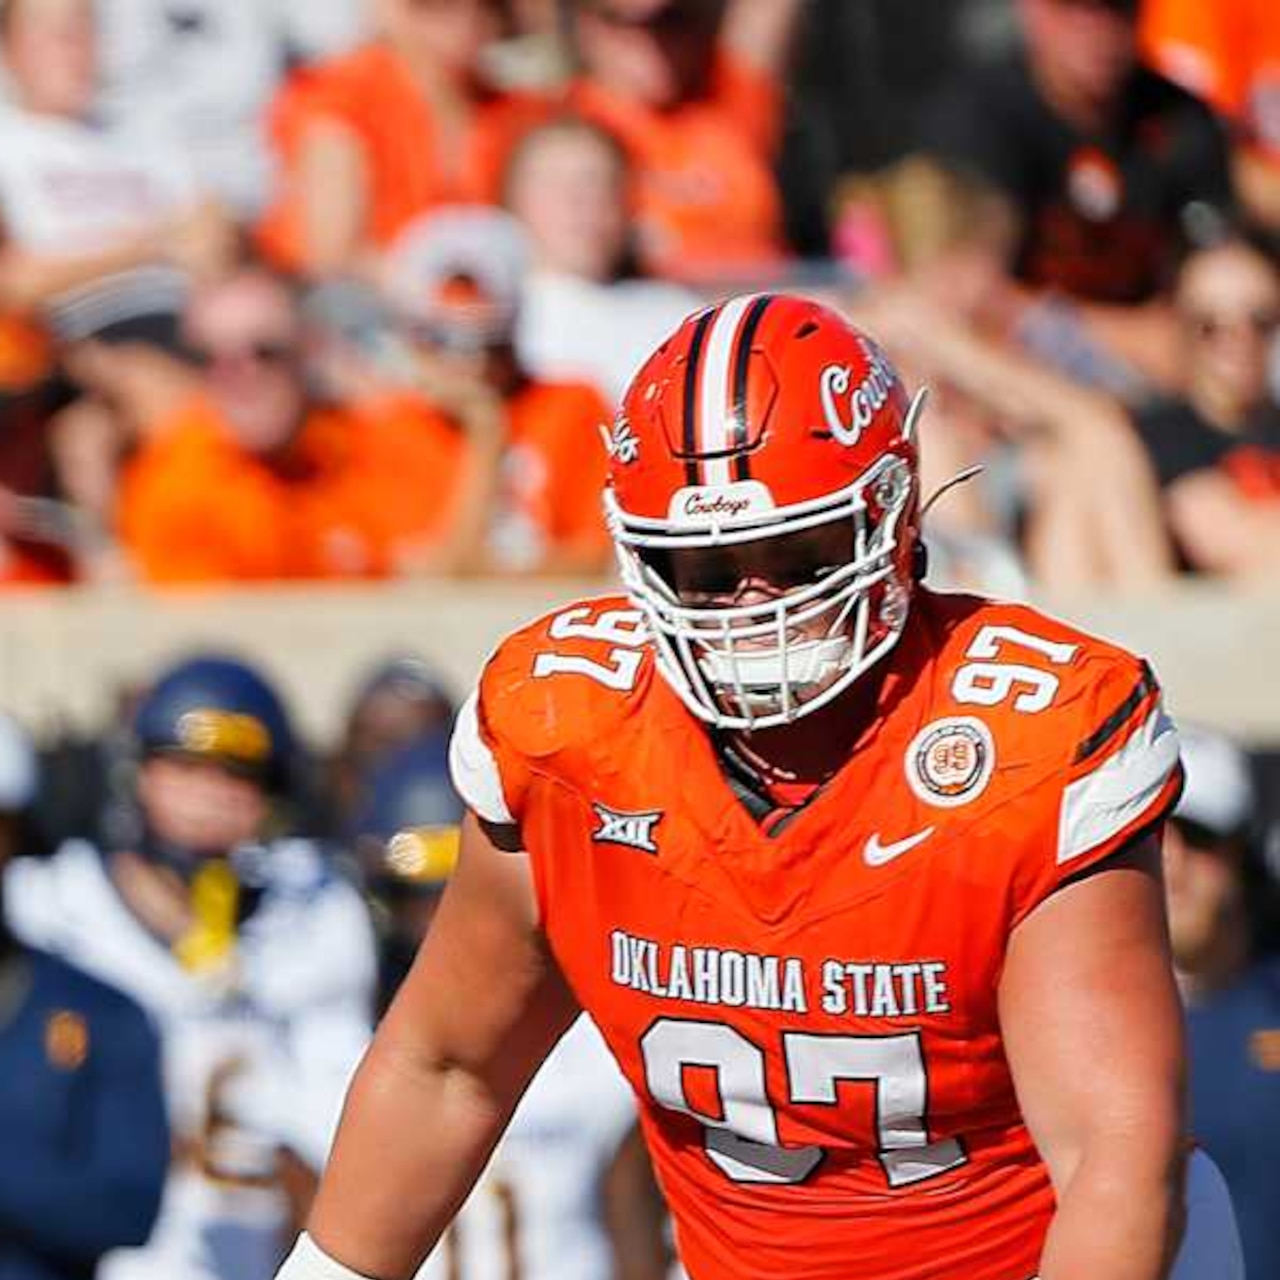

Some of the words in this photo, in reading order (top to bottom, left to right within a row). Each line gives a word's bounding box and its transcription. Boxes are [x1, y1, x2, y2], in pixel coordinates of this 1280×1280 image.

[684, 492, 751, 516] Cowboys
[531, 606, 654, 692] 97
[951, 624, 1085, 714] 97
[609, 928, 808, 1014] OKLAHOMA
[821, 957, 953, 1017] STATE
[639, 1015, 969, 1188] 97
